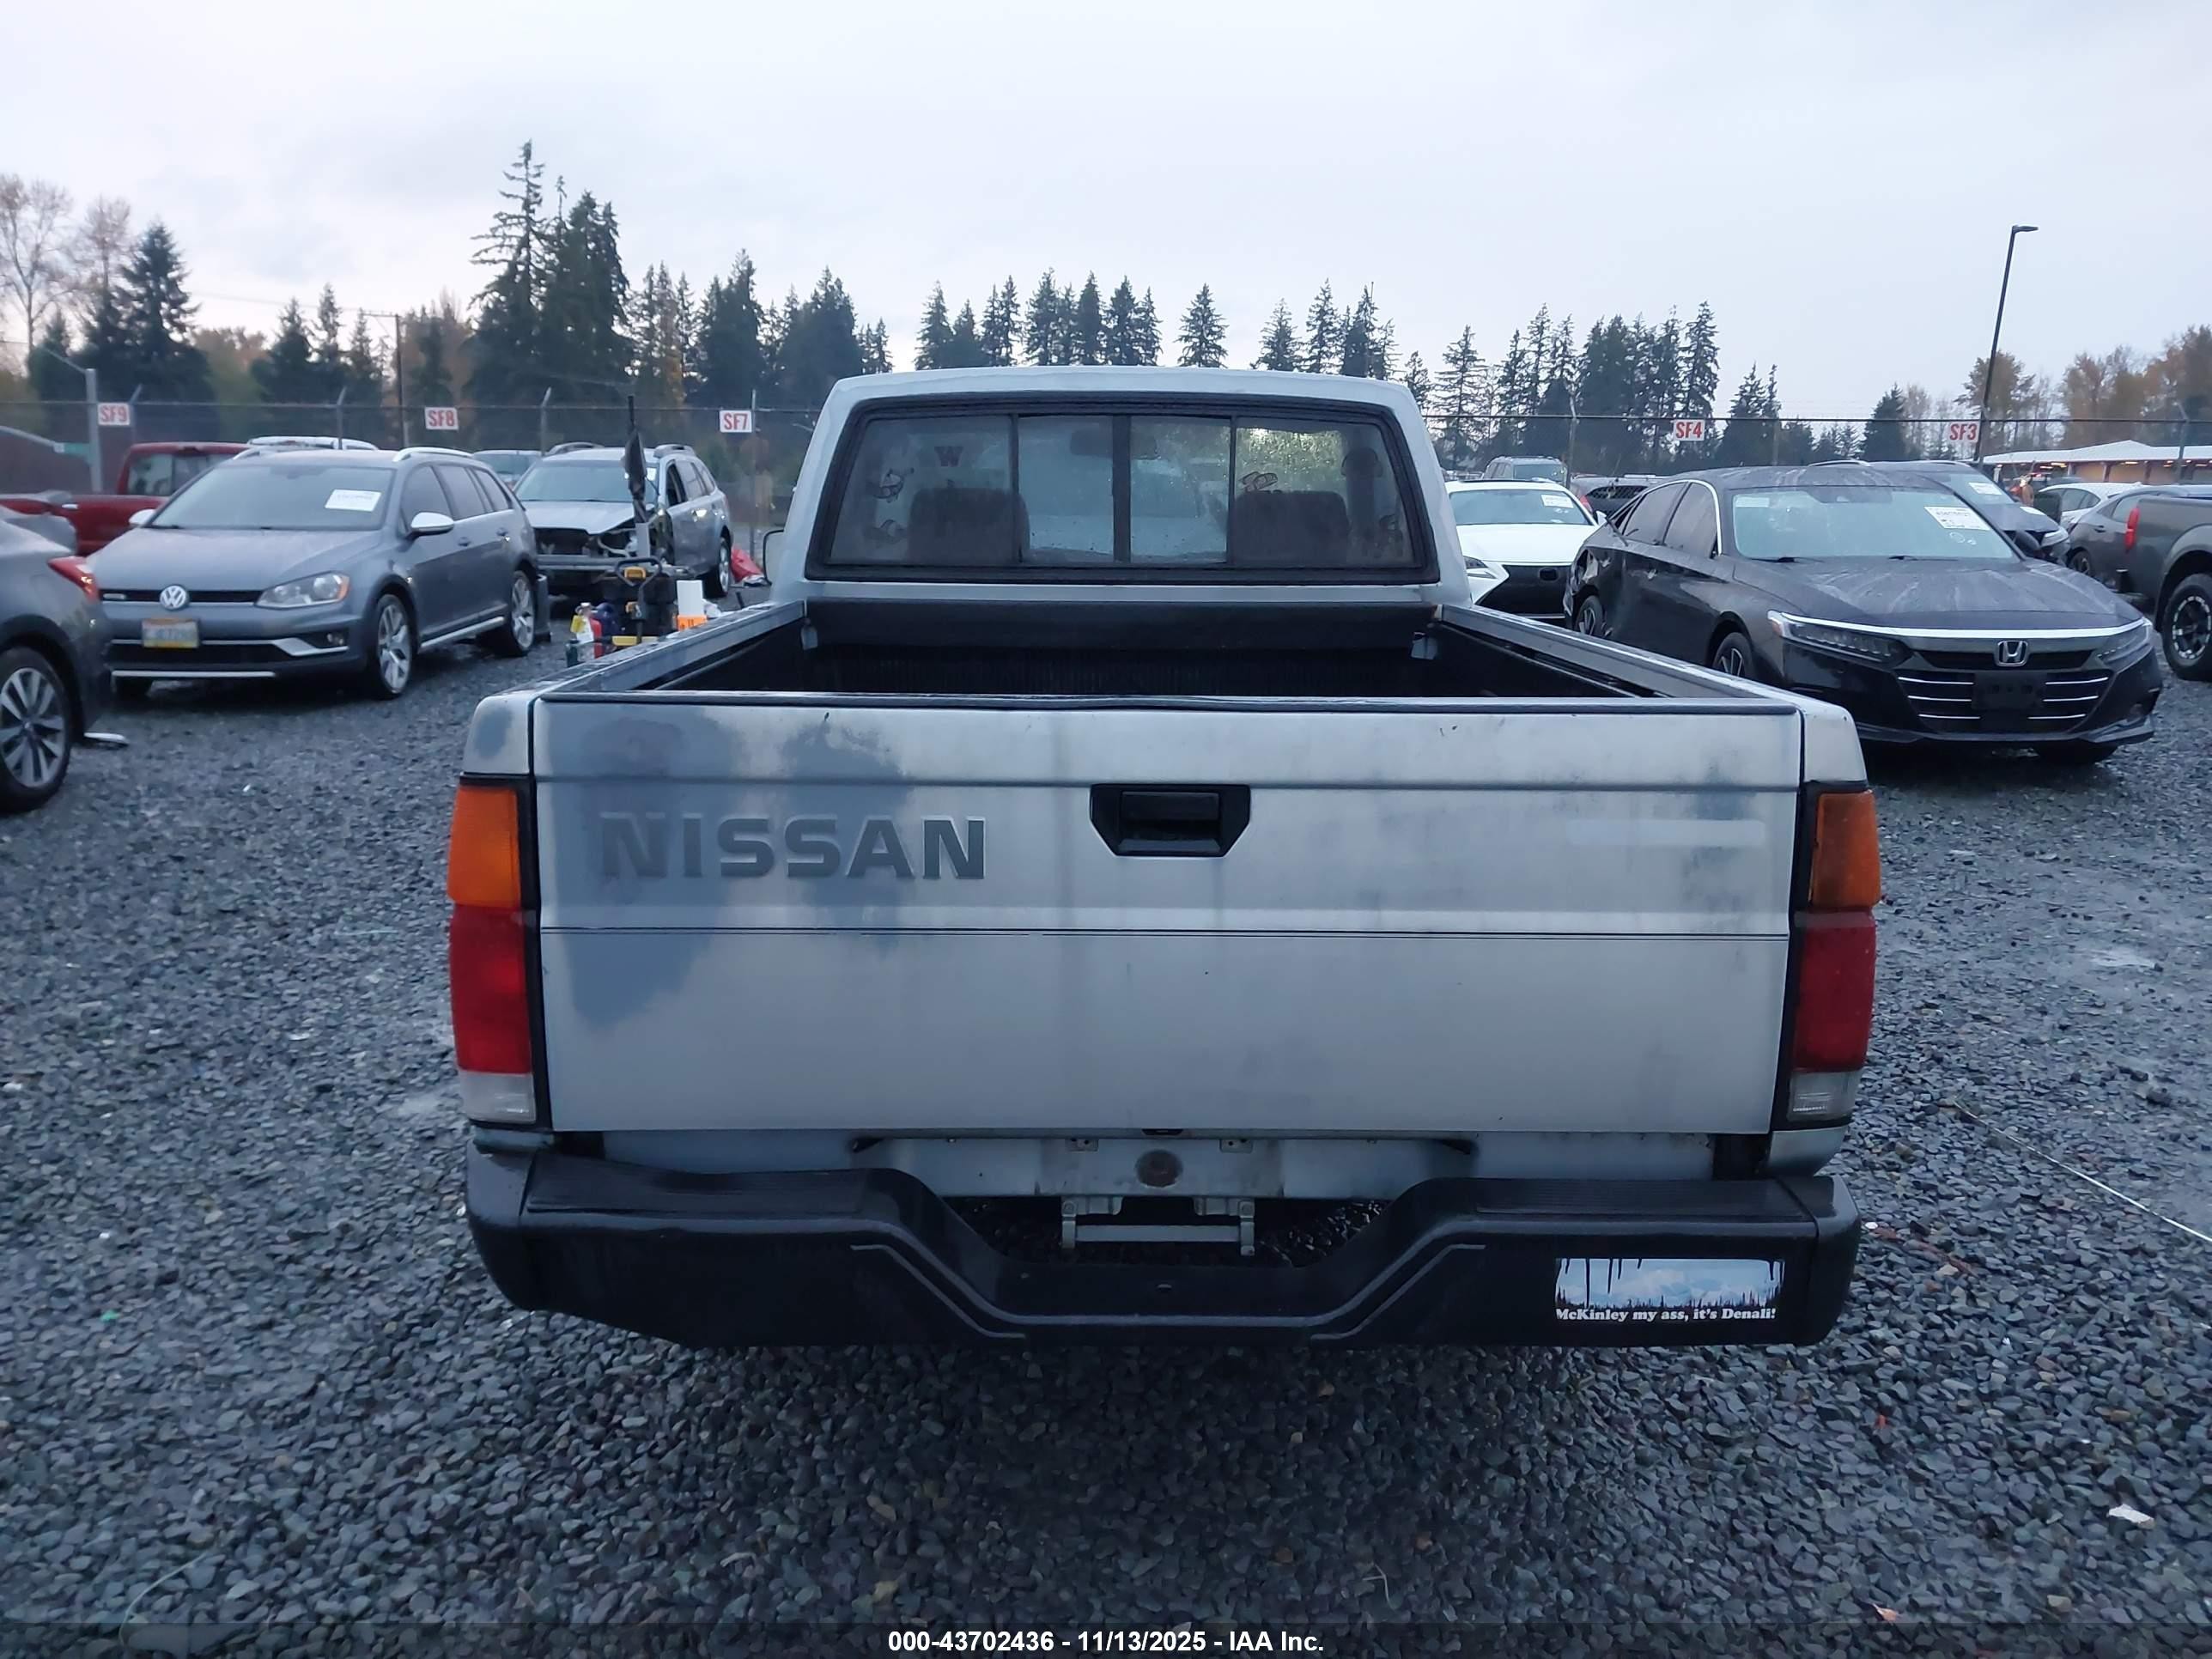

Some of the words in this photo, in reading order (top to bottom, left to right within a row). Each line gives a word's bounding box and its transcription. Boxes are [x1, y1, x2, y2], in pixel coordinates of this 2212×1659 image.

[100, 404, 128, 422] SF9
[428, 410, 454, 427] SF8
[724, 412, 749, 430] SF7
[1675, 421, 1703, 439] SF4
[1949, 422, 1978, 441] SF3
[601, 812, 987, 879] NISSAN
[1555, 1308, 1629, 1322] McKinley
[1632, 1311, 1658, 1322] my
[1661, 1310, 1690, 1322] ass,
[1721, 1308, 1777, 1320] Denali!
